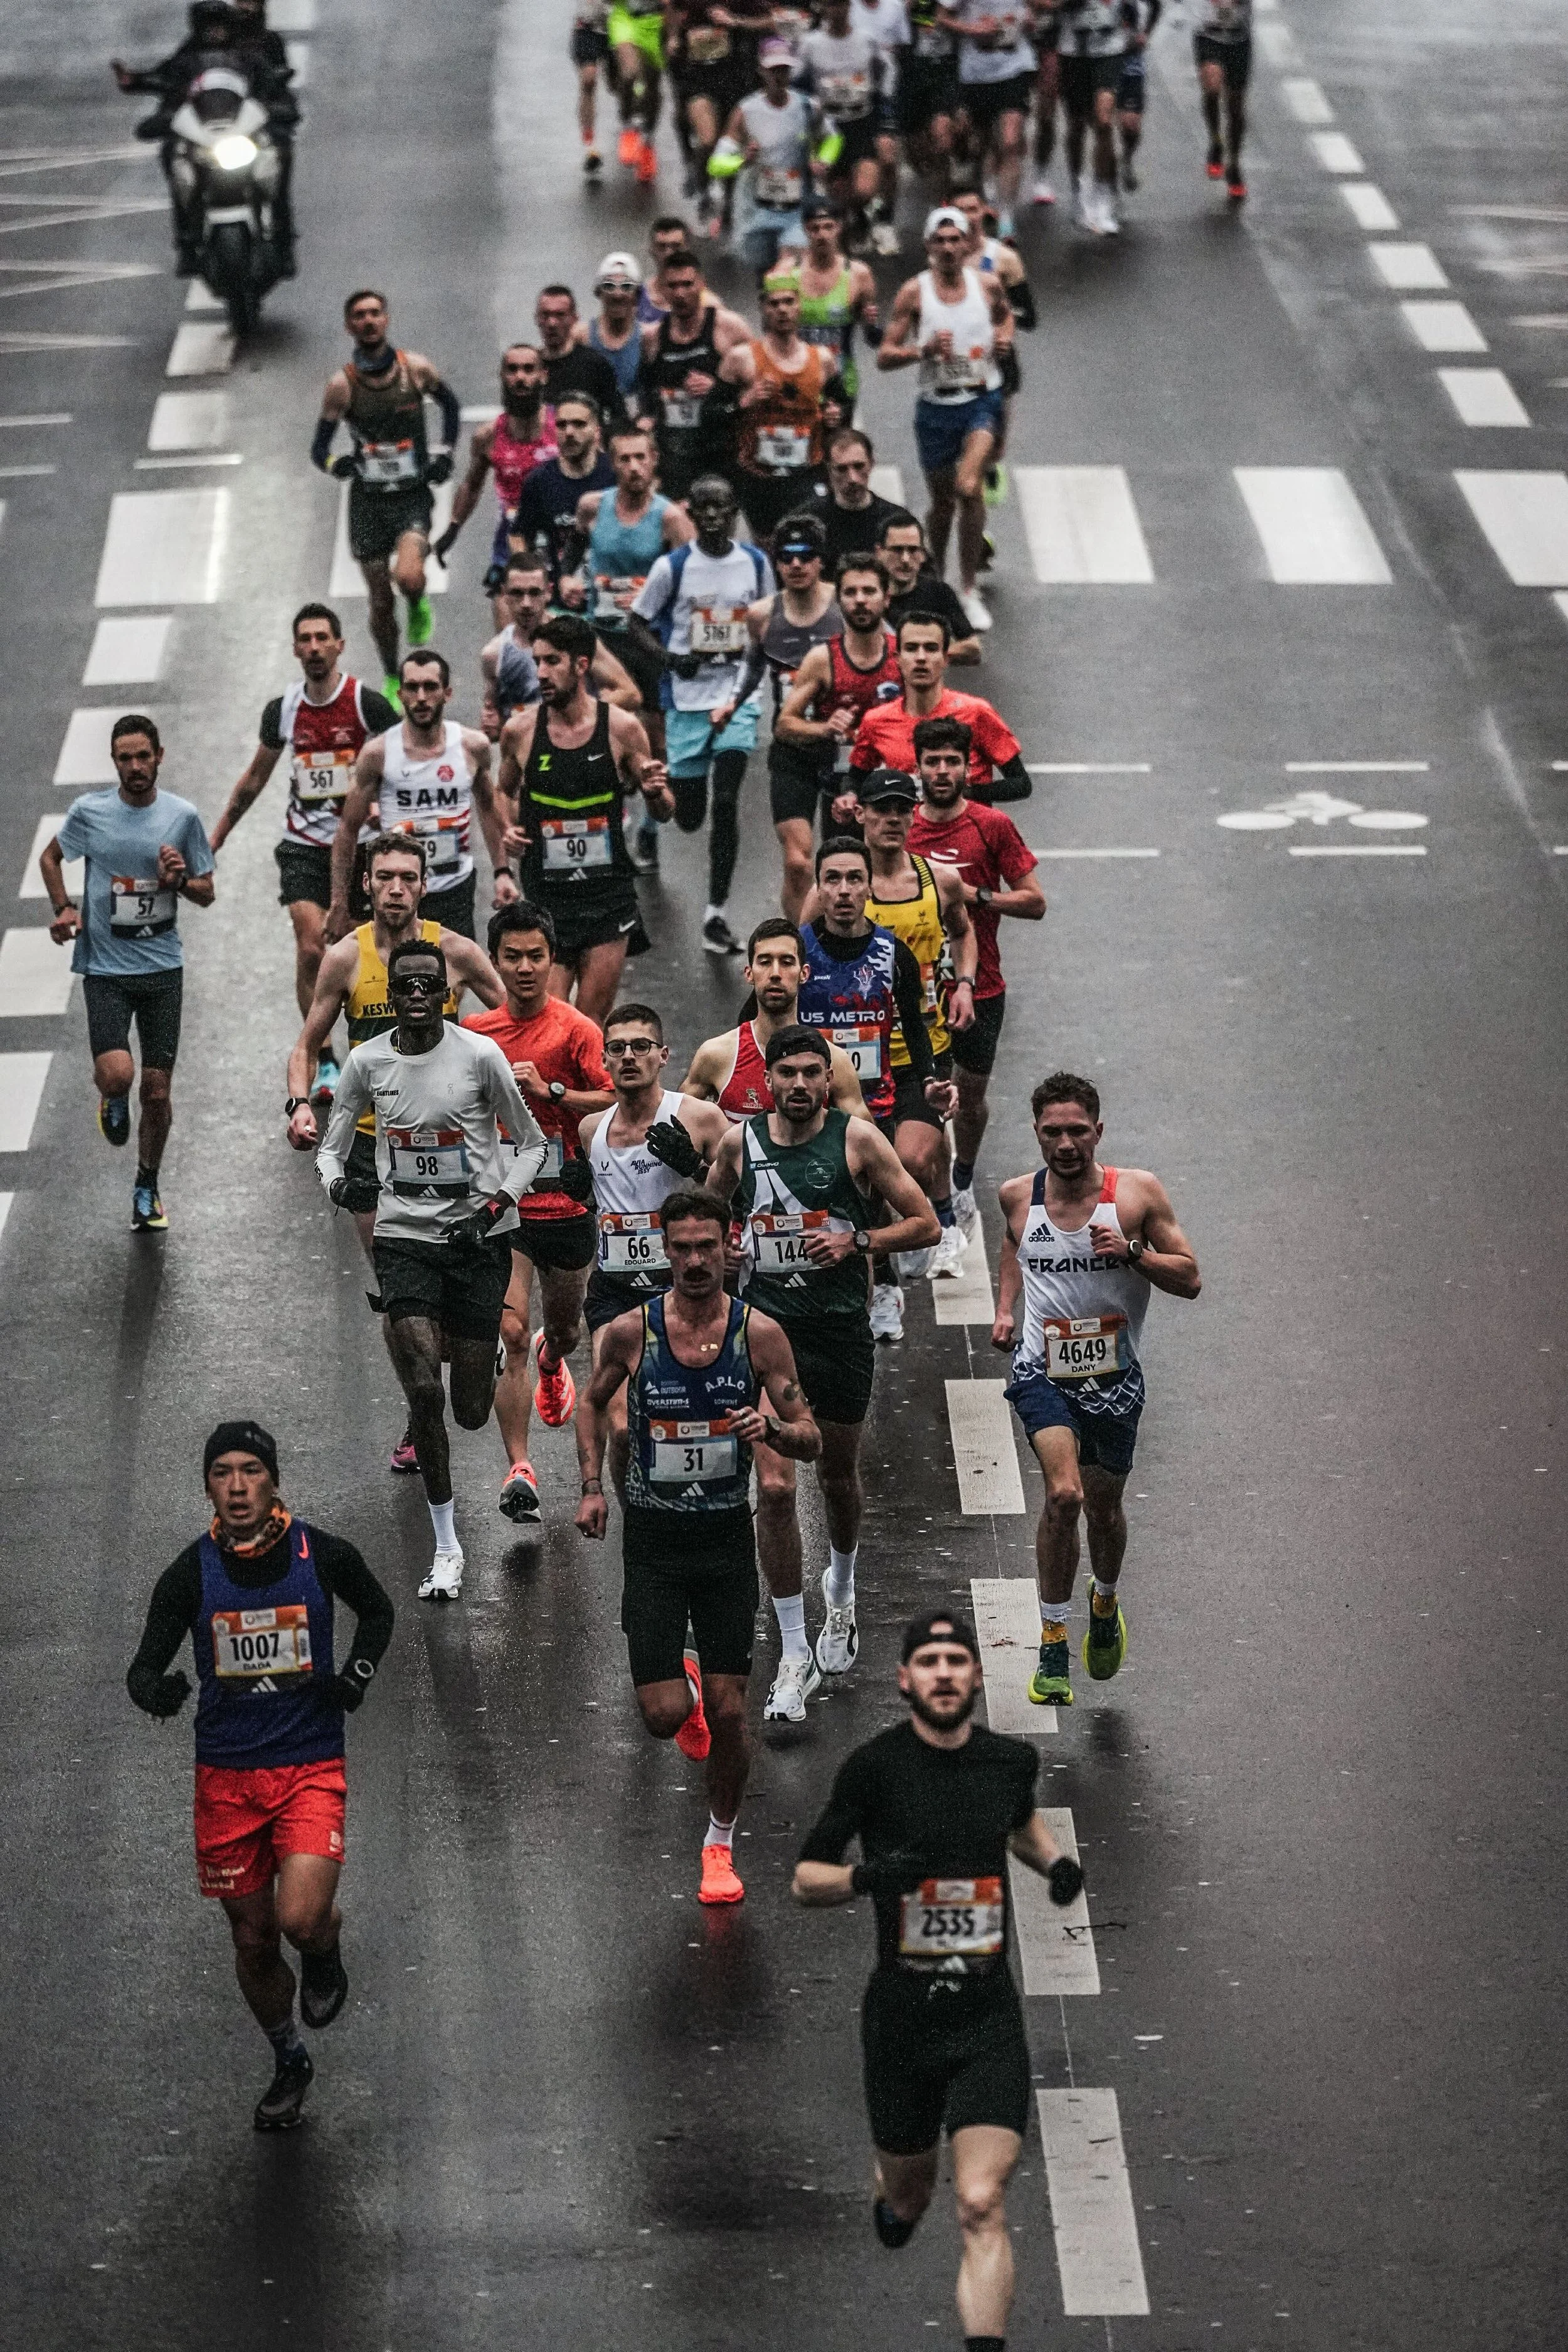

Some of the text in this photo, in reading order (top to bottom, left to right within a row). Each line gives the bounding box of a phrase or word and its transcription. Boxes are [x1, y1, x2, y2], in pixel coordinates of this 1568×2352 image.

[539, 754, 551, 771] Z
[310, 770, 333, 788] 567
[396, 788, 458, 807] SAM
[566, 839, 586, 857] 90
[138, 897, 154, 915] 57
[800, 1010, 885, 1023] US METRO
[416, 1155, 438, 1176] 98
[635, 1161, 662, 1170] RUNNING
[628, 1236, 650, 1259] 66
[775, 1239, 808, 1263] 144
[624, 1258, 656, 1266] EDOUARD
[1027, 1256, 1120, 1273] FRANCE
[1059, 1338, 1106, 1364] 4649
[1071, 1364, 1096, 1373] DANY
[684, 1448, 703, 1472] 31
[230, 1633, 280, 1661] 1007
[922, 1909, 975, 1937] 2535
